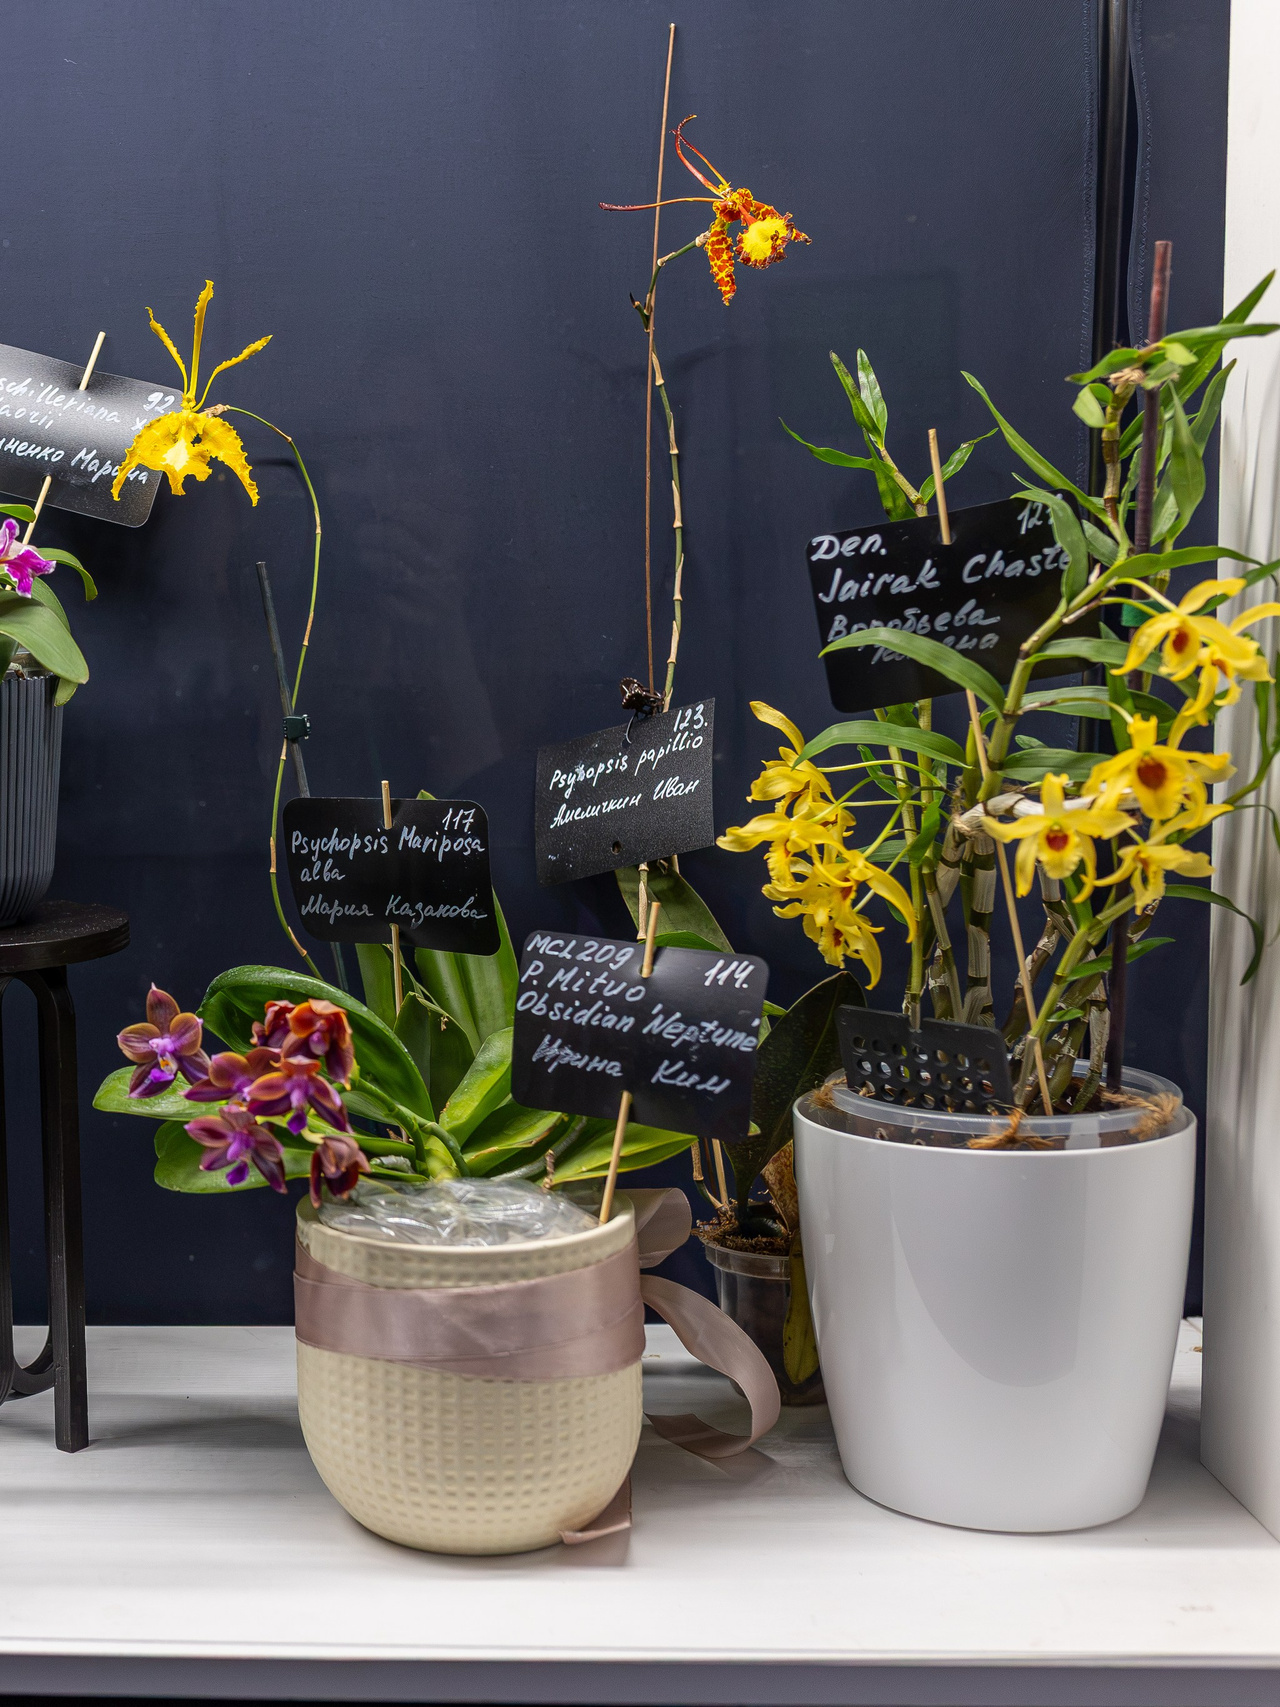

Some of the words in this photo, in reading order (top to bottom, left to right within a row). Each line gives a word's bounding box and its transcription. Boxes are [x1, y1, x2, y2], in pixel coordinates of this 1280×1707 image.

[810, 533, 888, 561] Den.
[817, 558, 941, 603] Jairak
[672, 703, 708, 732] 123.
[549, 792, 643, 829] Амеличкин
[652, 776, 700, 801] Иван
[291, 827, 389, 860] Psychopsis
[398, 825, 486, 862] Mariposa
[300, 858, 346, 882] alba
[300, 893, 374, 924] Мария
[384, 893, 488, 930] Казакова
[520, 959, 545, 986] P.
[516, 990, 636, 1033] Obsidian
[531, 1033, 624, 1078] Ирина
[650, 1059, 732, 1095] Ким
